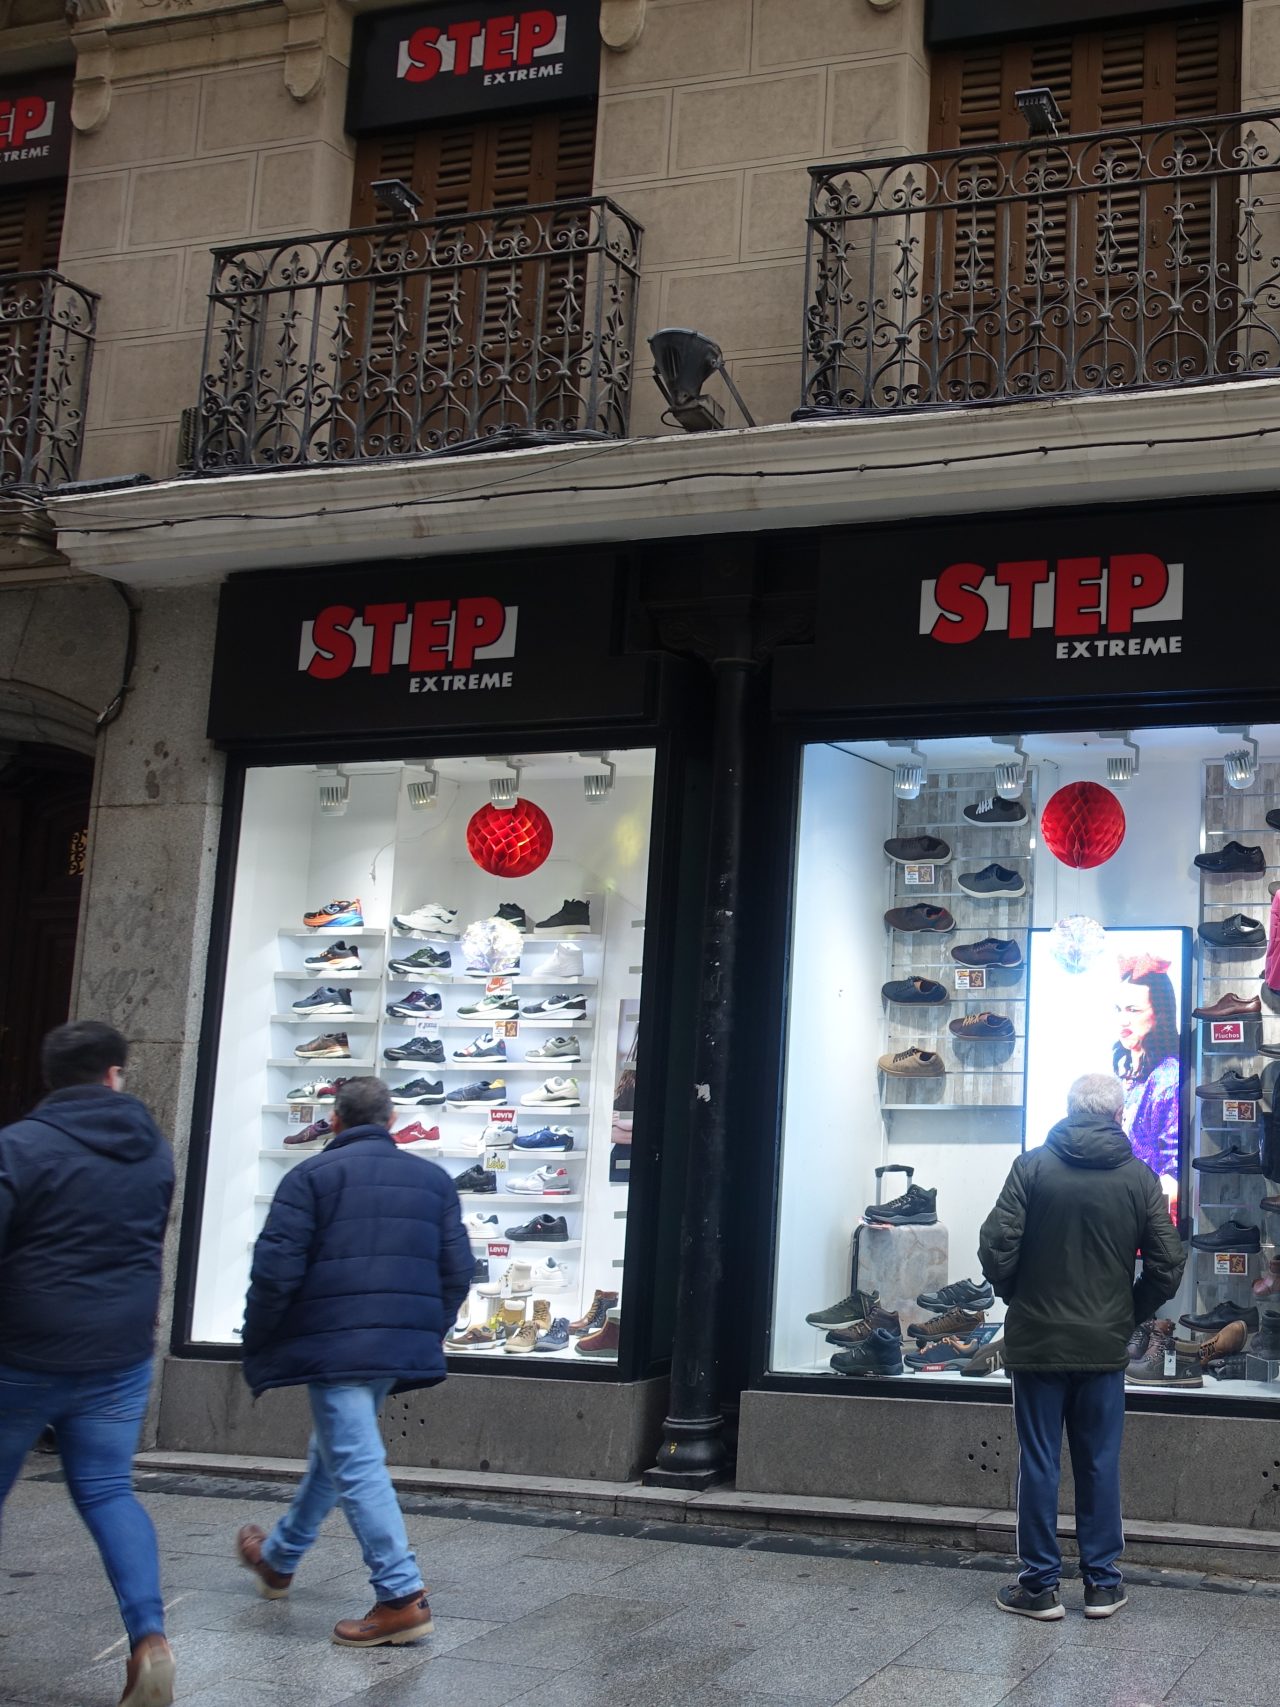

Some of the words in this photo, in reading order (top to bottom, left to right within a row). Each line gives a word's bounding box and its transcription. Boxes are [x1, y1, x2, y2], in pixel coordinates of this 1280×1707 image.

[405, 9, 557, 82] STEP
[483, 63, 563, 86] EXTREME
[0, 145, 50, 163] TREME
[931, 553, 1169, 644] STEP
[307, 597, 506, 681] STEP
[1056, 636, 1182, 659] EXTREME
[409, 671, 513, 693] EXTREME
